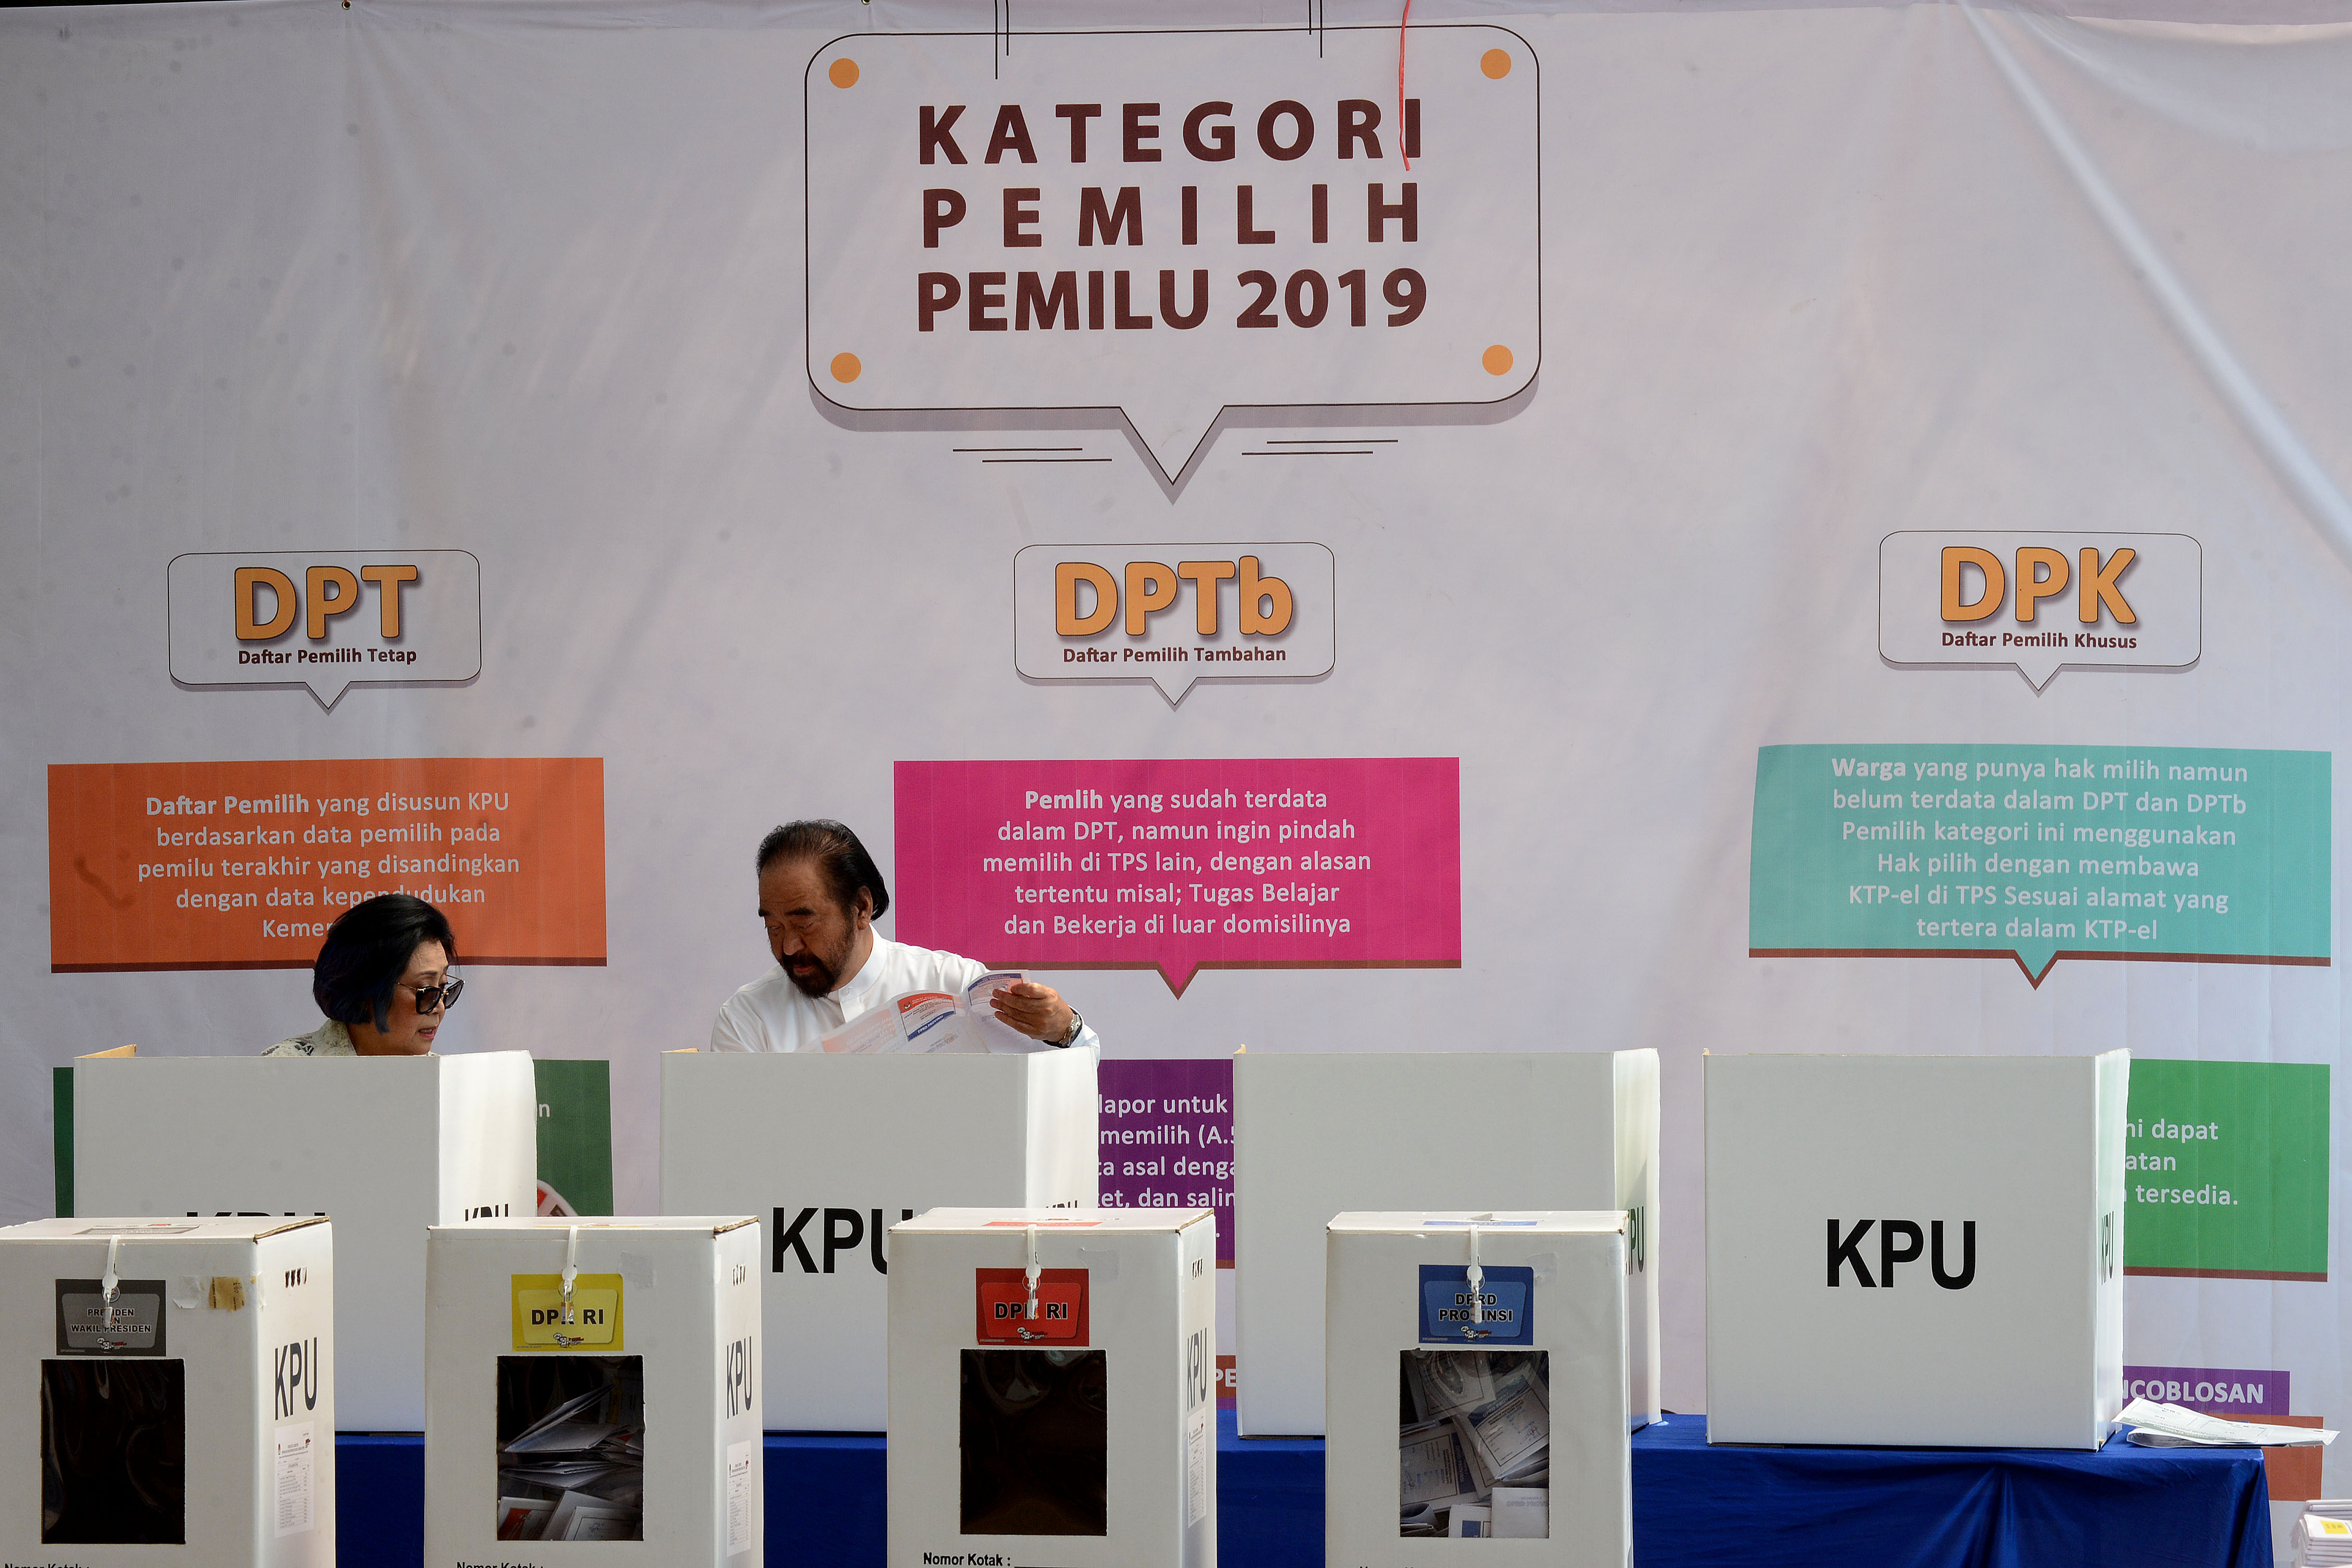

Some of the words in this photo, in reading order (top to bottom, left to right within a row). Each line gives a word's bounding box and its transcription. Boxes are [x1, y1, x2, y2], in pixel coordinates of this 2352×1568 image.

[920, 99, 1420, 164] KATEGORI
[923, 183, 1417, 248] PEMILIH
[918, 270, 1208, 332] PEMILU
[1237, 268, 1426, 328] 2019
[1056, 556, 1292, 636] DPTb
[1941, 547, 2136, 623] DPK
[235, 565, 418, 641] DPT
[1942, 632, 1996, 646] Daftar
[2003, 632, 2067, 647] Pemilih
[2075, 633, 2136, 648] Khusus
[239, 649, 291, 664] Daftar
[298, 648, 361, 663] Pemilih
[368, 649, 416, 665] Tetap
[1064, 647, 1117, 662] Daftar
[1124, 647, 1187, 662] Pemilih
[1194, 646, 1285, 661] Tambahan
[1832, 758, 1906, 781] Warga
[1914, 763, 1967, 781] yang
[1977, 763, 2045, 781] punya
[2055, 758, 2094, 778] hak
[2104, 760, 2159, 779] milih
[2170, 766, 2247, 782] namun
[147, 795, 216, 815] Daftar
[225, 793, 309, 814] Pemilih
[317, 798, 369, 816] yang
[377, 792, 460, 811] disusun
[469, 792, 508, 810] KPU
[1026, 789, 1102, 808] Pemlih
[1110, 794, 1163, 813] yang
[1171, 789, 1236, 808] sudah
[1245, 788, 1326, 807] terdata
[1834, 789, 1902, 808] belum
[1911, 789, 1994, 808] terdata
[2004, 789, 2073, 809] dalam
[2084, 792, 2128, 811] DPT
[2136, 792, 2177, 812] dan
[2188, 794, 2246, 814] DPTb
[157, 826, 294, 846] berdasarkan
[304, 825, 351, 843] data
[361, 823, 442, 847] pemilih
[451, 823, 499, 845] pada
[998, 821, 1064, 840] dalam
[1075, 822, 1123, 843] DPT,
[1133, 826, 1208, 839] namun
[1218, 820, 1270, 843] ingin
[1280, 819, 1354, 843] pindah
[1843, 820, 1925, 840] Pemilih
[1935, 820, 2028, 845] kategori
[2038, 823, 2064, 841] ini
[2074, 825, 2235, 848] menggunakan
[139, 858, 213, 882] pemilu
[222, 856, 310, 876] terakhir
[317, 860, 370, 878] yang
[378, 853, 519, 876] disandingkan
[984, 852, 1072, 872] memilih
[1081, 852, 1099, 871] di
[1108, 853, 1147, 871] TPS
[1157, 852, 1202, 874] lain,
[1211, 851, 1292, 875] dengan
[1301, 851, 1370, 870] alasan
[1879, 852, 1920, 872] Hak
[1929, 853, 1976, 876] pilih
[1986, 853, 2069, 877] dengan
[2079, 855, 2198, 876] membawa
[177, 889, 257, 911] dengan
[266, 887, 313, 906] data
[1015, 886, 1107, 903] tertentu
[1117, 883, 1181, 905] misal;
[1189, 884, 1254, 906] Tugas
[1263, 882, 1339, 905] Belajar
[1850, 884, 1919, 904] KTP-el
[1928, 885, 1947, 904] di
[1956, 886, 1996, 904] TPS
[2005, 886, 2077, 905] Sesuai
[2087, 887, 2166, 908] alamat
[2174, 895, 2228, 914] yang
[1005, 915, 1044, 934] dan
[1055, 914, 1135, 938] Bekerja
[1145, 914, 1163, 933] di
[1173, 914, 1216, 933] luar
[1224, 913, 1350, 937] domisilinya
[1917, 919, 1996, 937] tertera
[2006, 917, 2075, 937] dalam
[2086, 920, 2157, 939] KTP-el
[1164, 1094, 1228, 1113] untuk
[1101, 1125, 1189, 1144] memilih
[2152, 1119, 2218, 1143] dapat
[1123, 1156, 1165, 1175] asal
[1098, 1190, 1130, 1208] et,
[1138, 1187, 1178, 1207] dan
[2136, 1184, 2237, 1205] tersedia.
[1828, 1219, 1975, 1289] KPU
[2101, 1211, 2114, 1285] KPU
[532, 1309, 574, 1325] DP
[583, 1309, 604, 1325] RI
[1046, 1302, 1068, 1319] RI
[1439, 1309, 1513, 1321] PROINSI
[275, 1337, 317, 1420] KPU
[727, 1336, 752, 1419] KPU
[1187, 1327, 1207, 1412] KPU
[923, 1552, 964, 1565] Nomor
[967, 1553, 1003, 1566] Kotak
